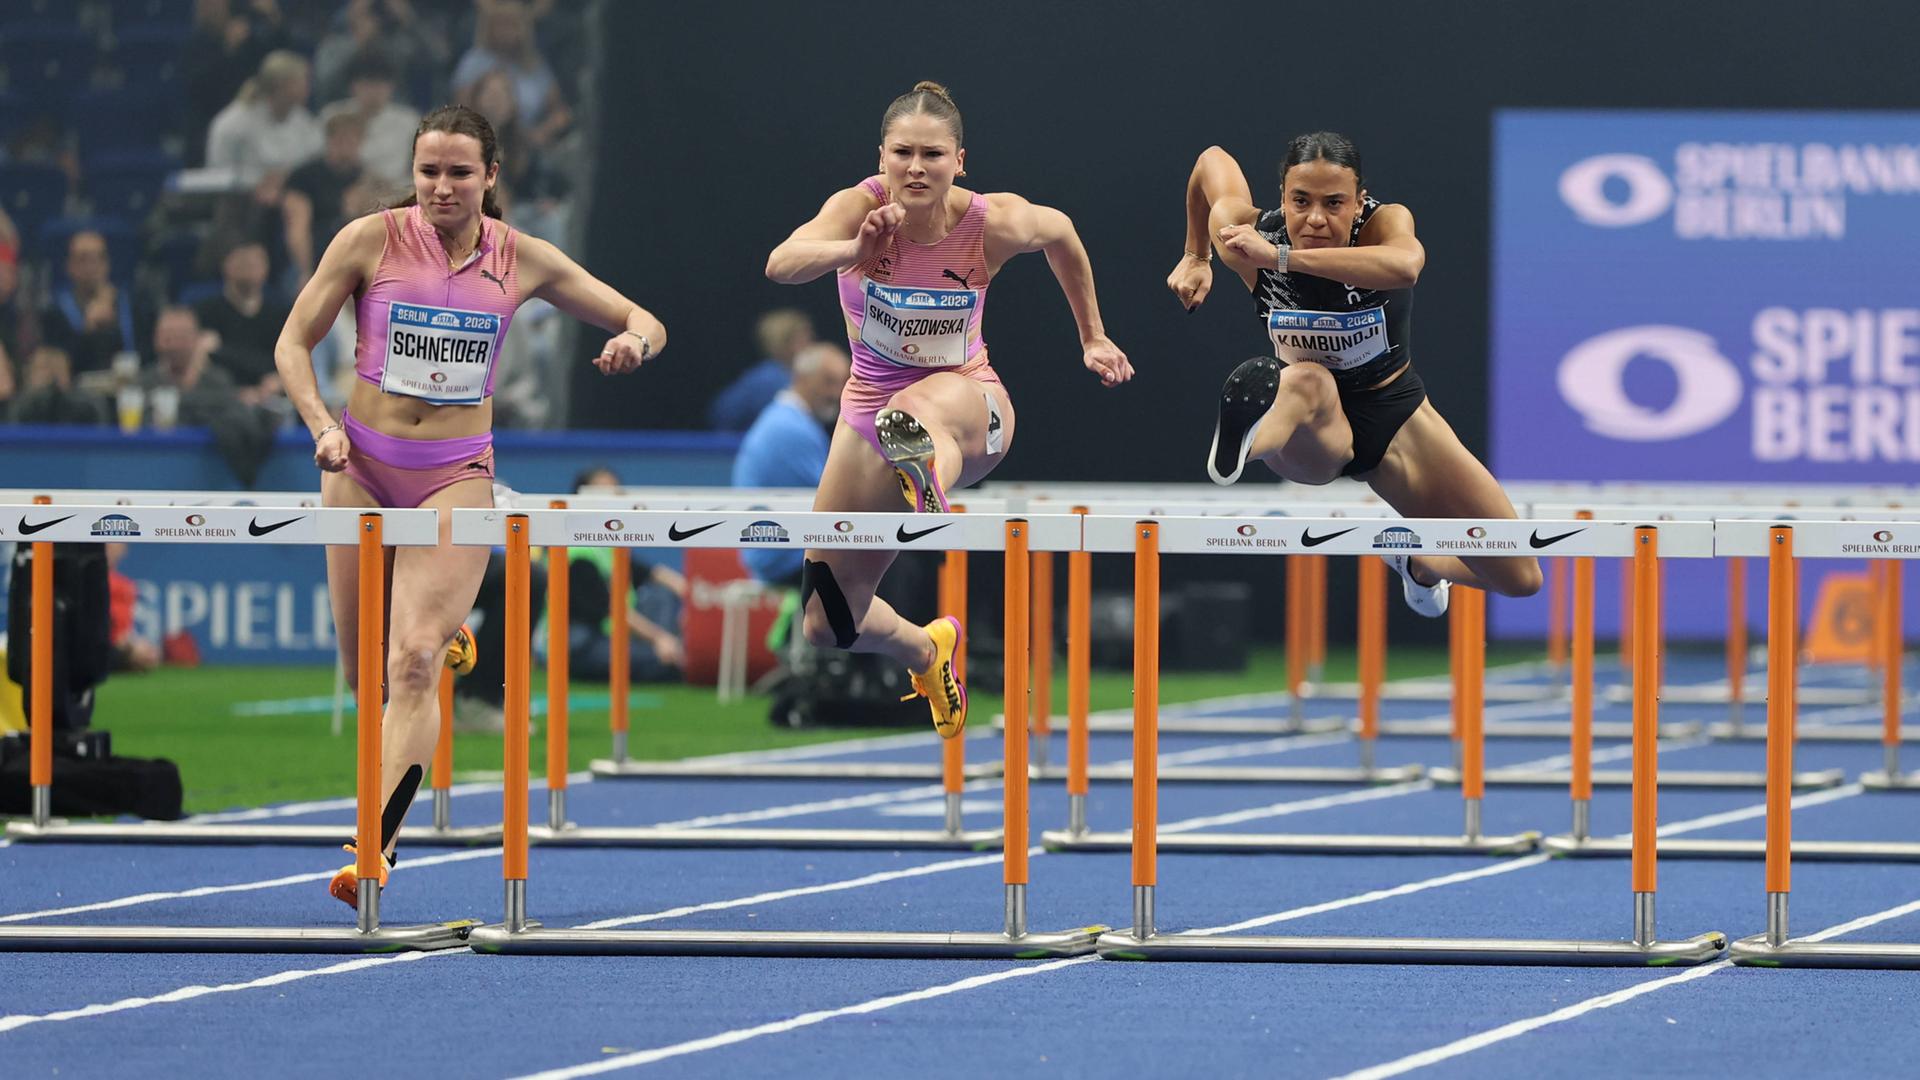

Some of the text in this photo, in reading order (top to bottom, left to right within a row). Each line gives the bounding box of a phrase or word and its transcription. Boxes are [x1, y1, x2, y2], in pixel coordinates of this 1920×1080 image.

[1675, 191, 1846, 238] BERLIN
[874, 288, 902, 304] BERLIN
[940, 294, 968, 306] 2026
[398, 308, 428, 323] BERLIN
[464, 316, 492, 330] 2026
[869, 304, 965, 337] SKRZYSZOWSKA
[1278, 315, 1308, 327] BERLIN
[1347, 313, 1376, 328] 2026
[1277, 326, 1380, 352] KAMBUNDJI
[393, 331, 489, 364] SCHNEIDER
[918, 355, 948, 364] BERLIN
[401, 380, 470, 393] SPIELBANK BERLIN
[988, 410, 1001, 434] 4
[100, 519, 130, 530] ISTAF
[154, 528, 236, 537] SPIELBANK BERLIN
[574, 532, 655, 542] SPIELBANK BERLIN
[750, 526, 780, 537] ISTAF
[803, 534, 884, 544] SPIELBANK BERLIN
[1206, 537, 1288, 548] SPIELBANK BERLIN
[1382, 532, 1412, 543] ISTAF
[1436, 540, 1517, 549] SPIELBANK BERLIN
[1842, 544, 1890, 552] SPIELBANK
